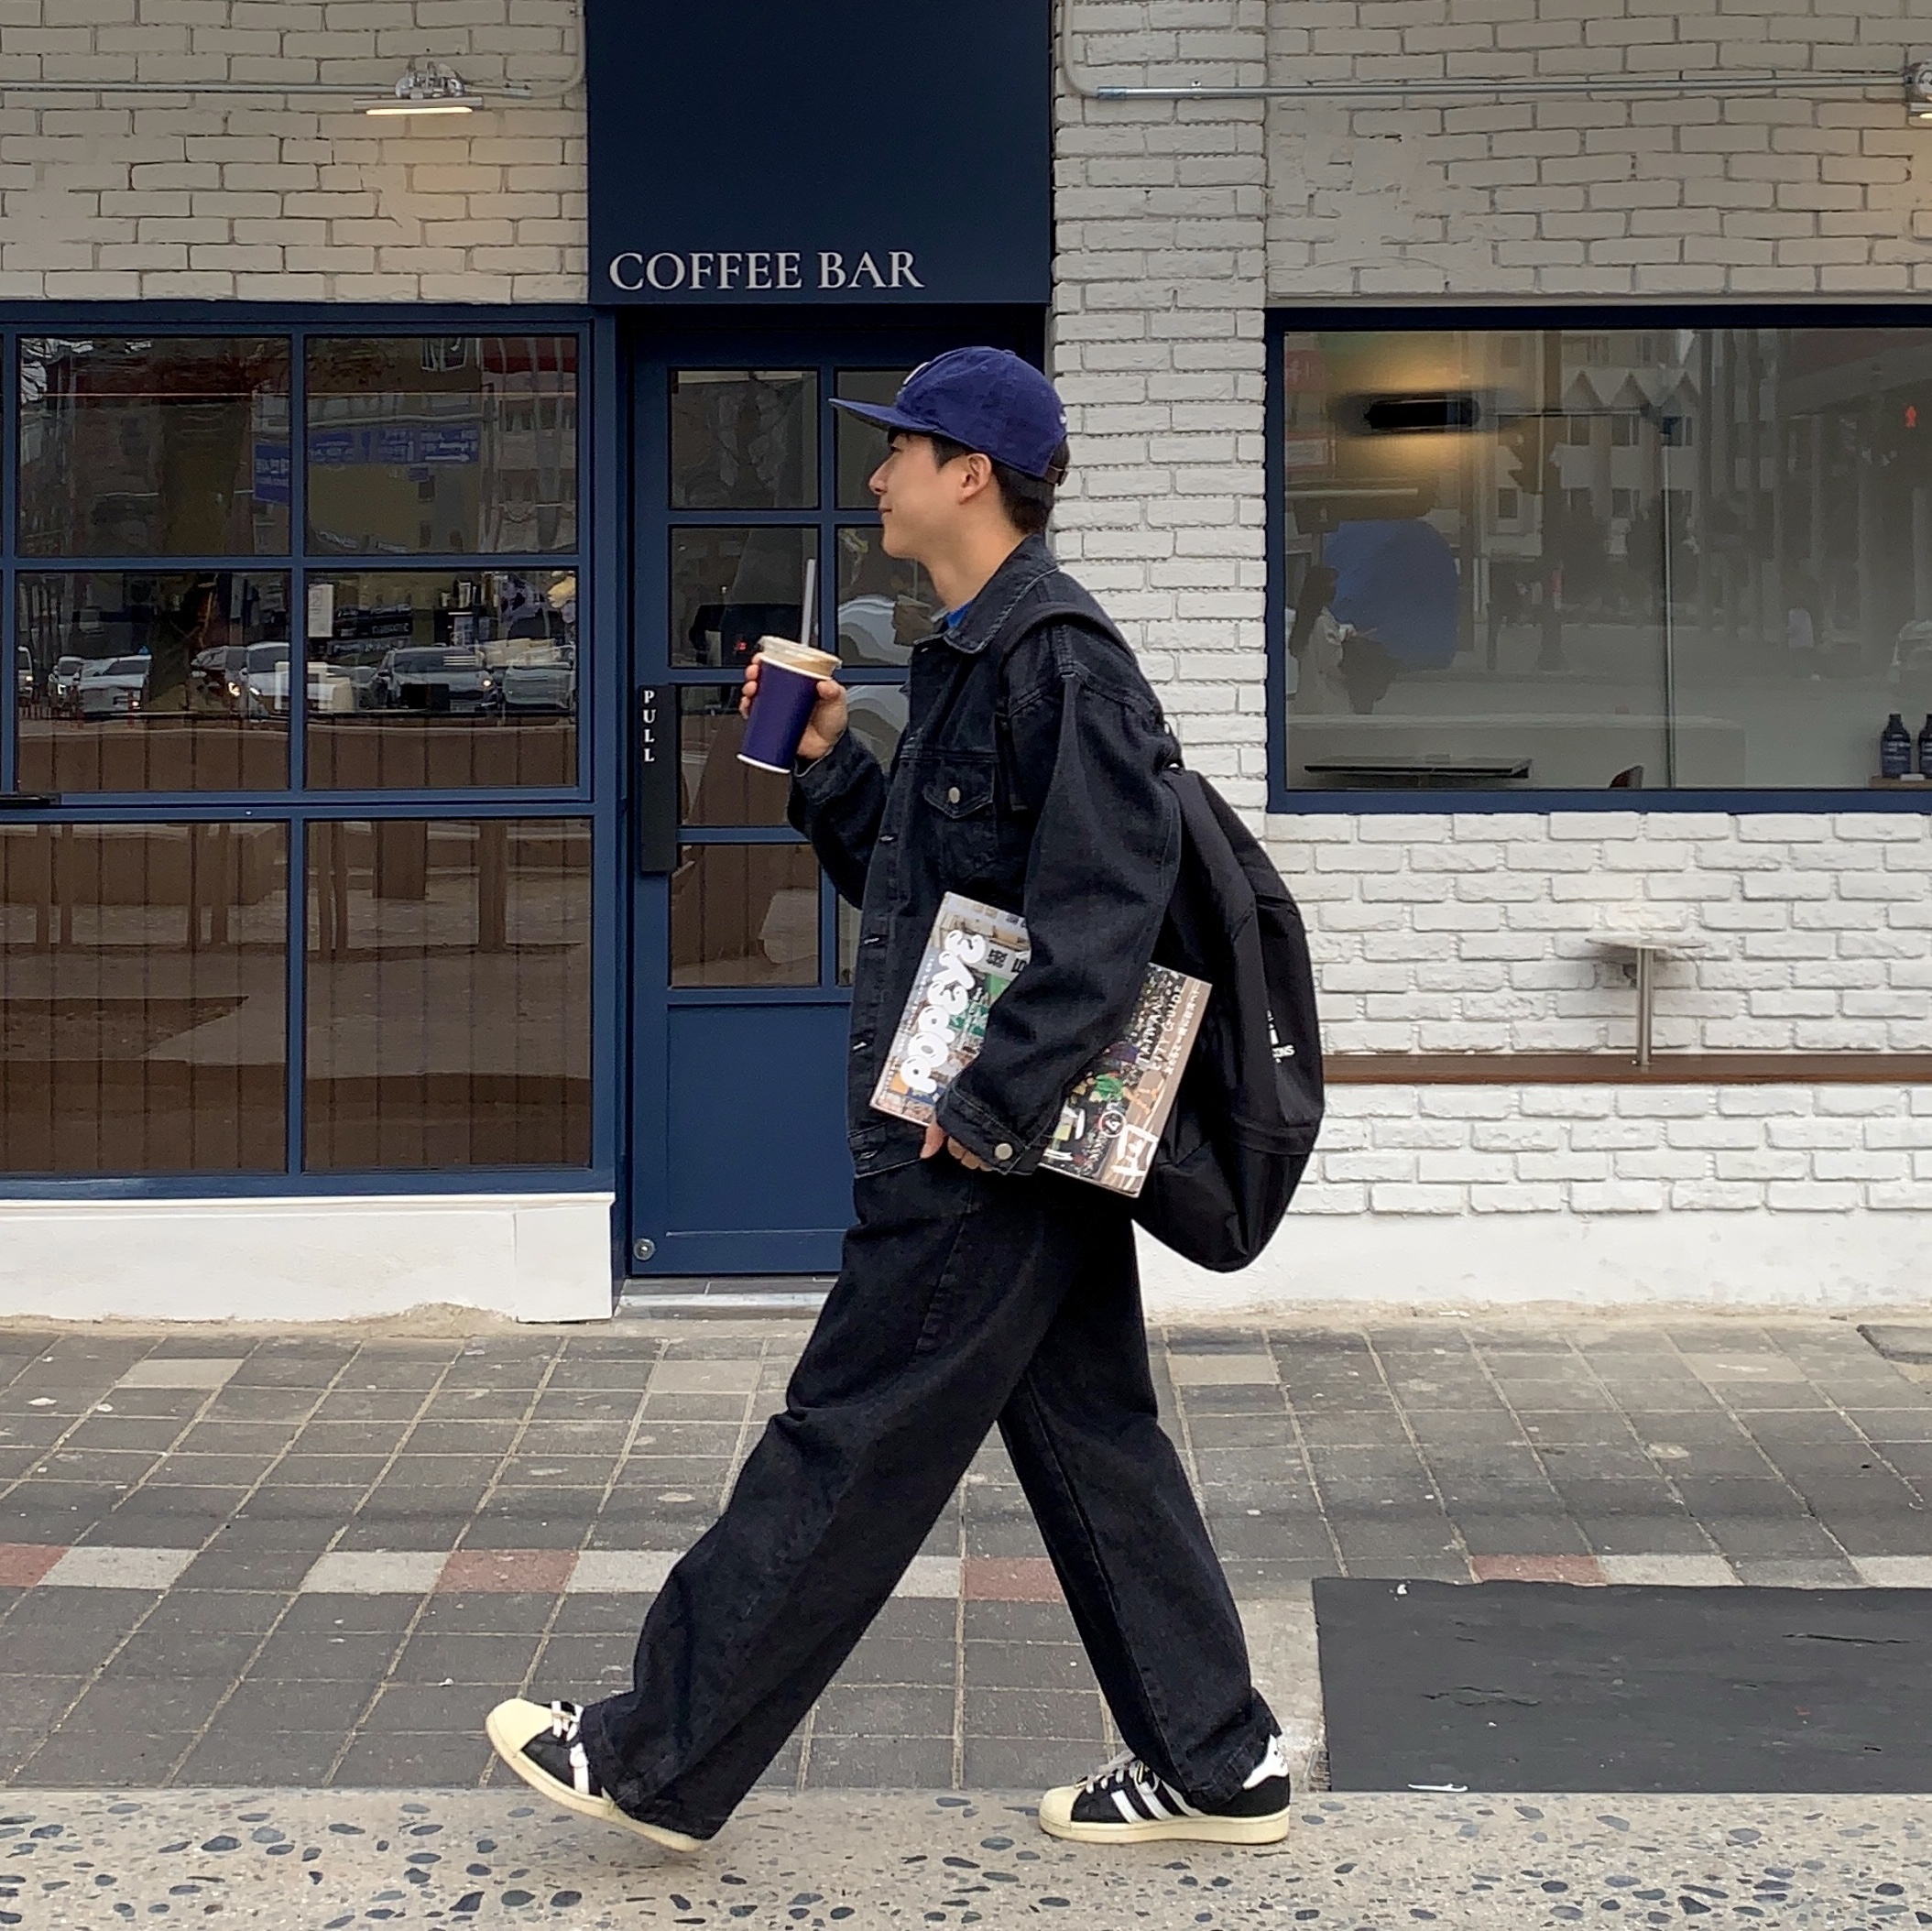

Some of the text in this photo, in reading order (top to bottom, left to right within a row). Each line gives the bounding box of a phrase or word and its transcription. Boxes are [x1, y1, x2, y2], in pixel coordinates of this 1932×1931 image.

[609, 251, 925, 290] COFFEE BAR
[643, 690, 657, 762] PULL
[901, 930, 987, 1094] POPEYE
